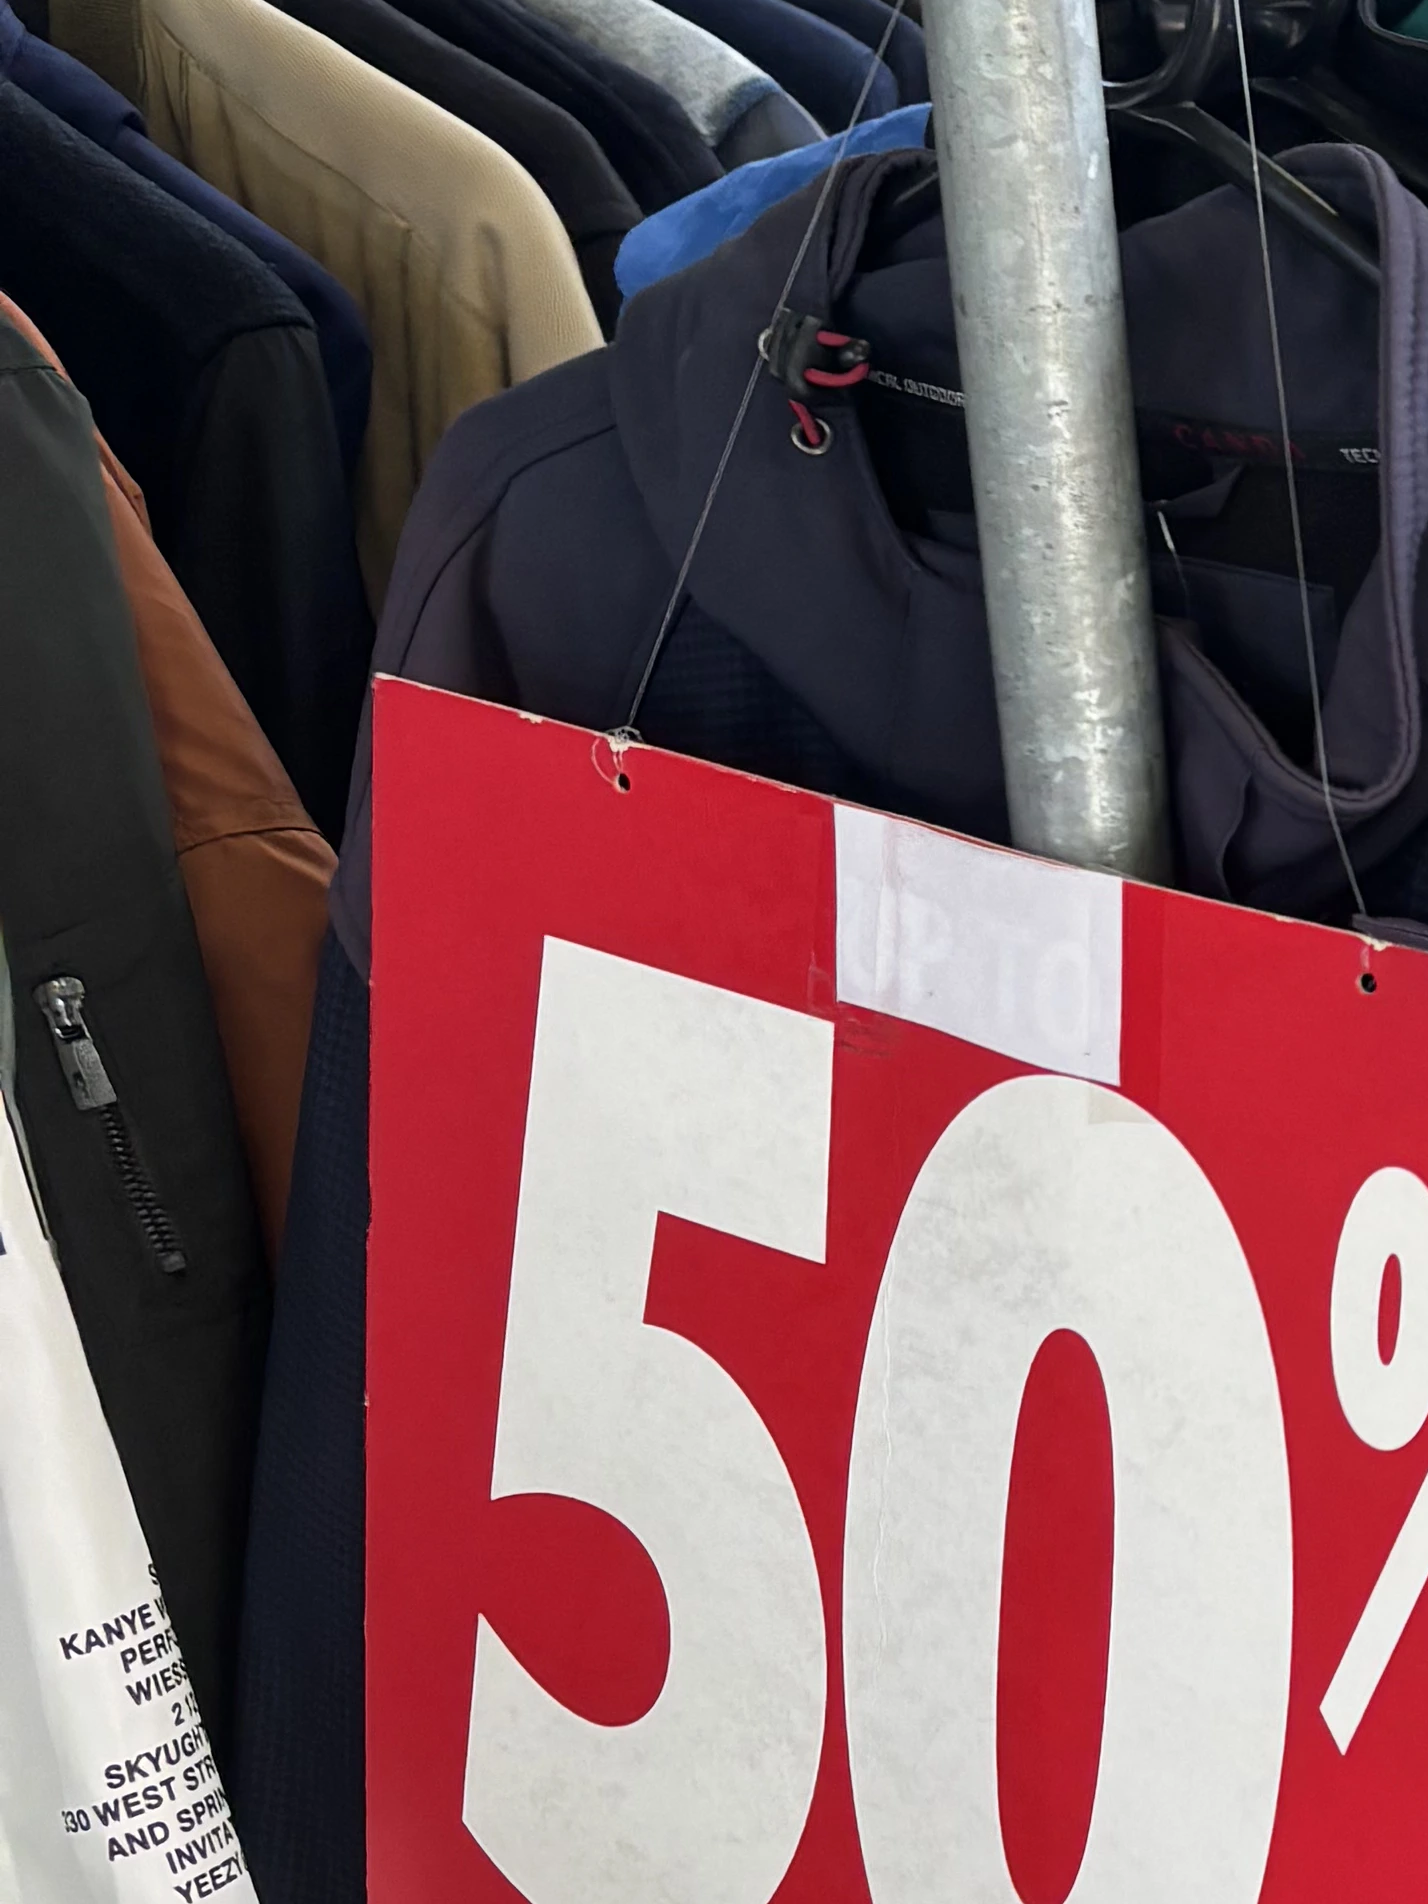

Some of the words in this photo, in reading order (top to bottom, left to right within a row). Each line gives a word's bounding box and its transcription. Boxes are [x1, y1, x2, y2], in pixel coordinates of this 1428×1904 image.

[59, 1602, 156, 1661] KANYE
[172, 1701, 185, 1727] 2
[92, 1776, 176, 1827] WEST
[108, 1821, 170, 1862] AND
[165, 1820, 234, 1875] INVITA
[173, 1850, 243, 1904] YEEZY
